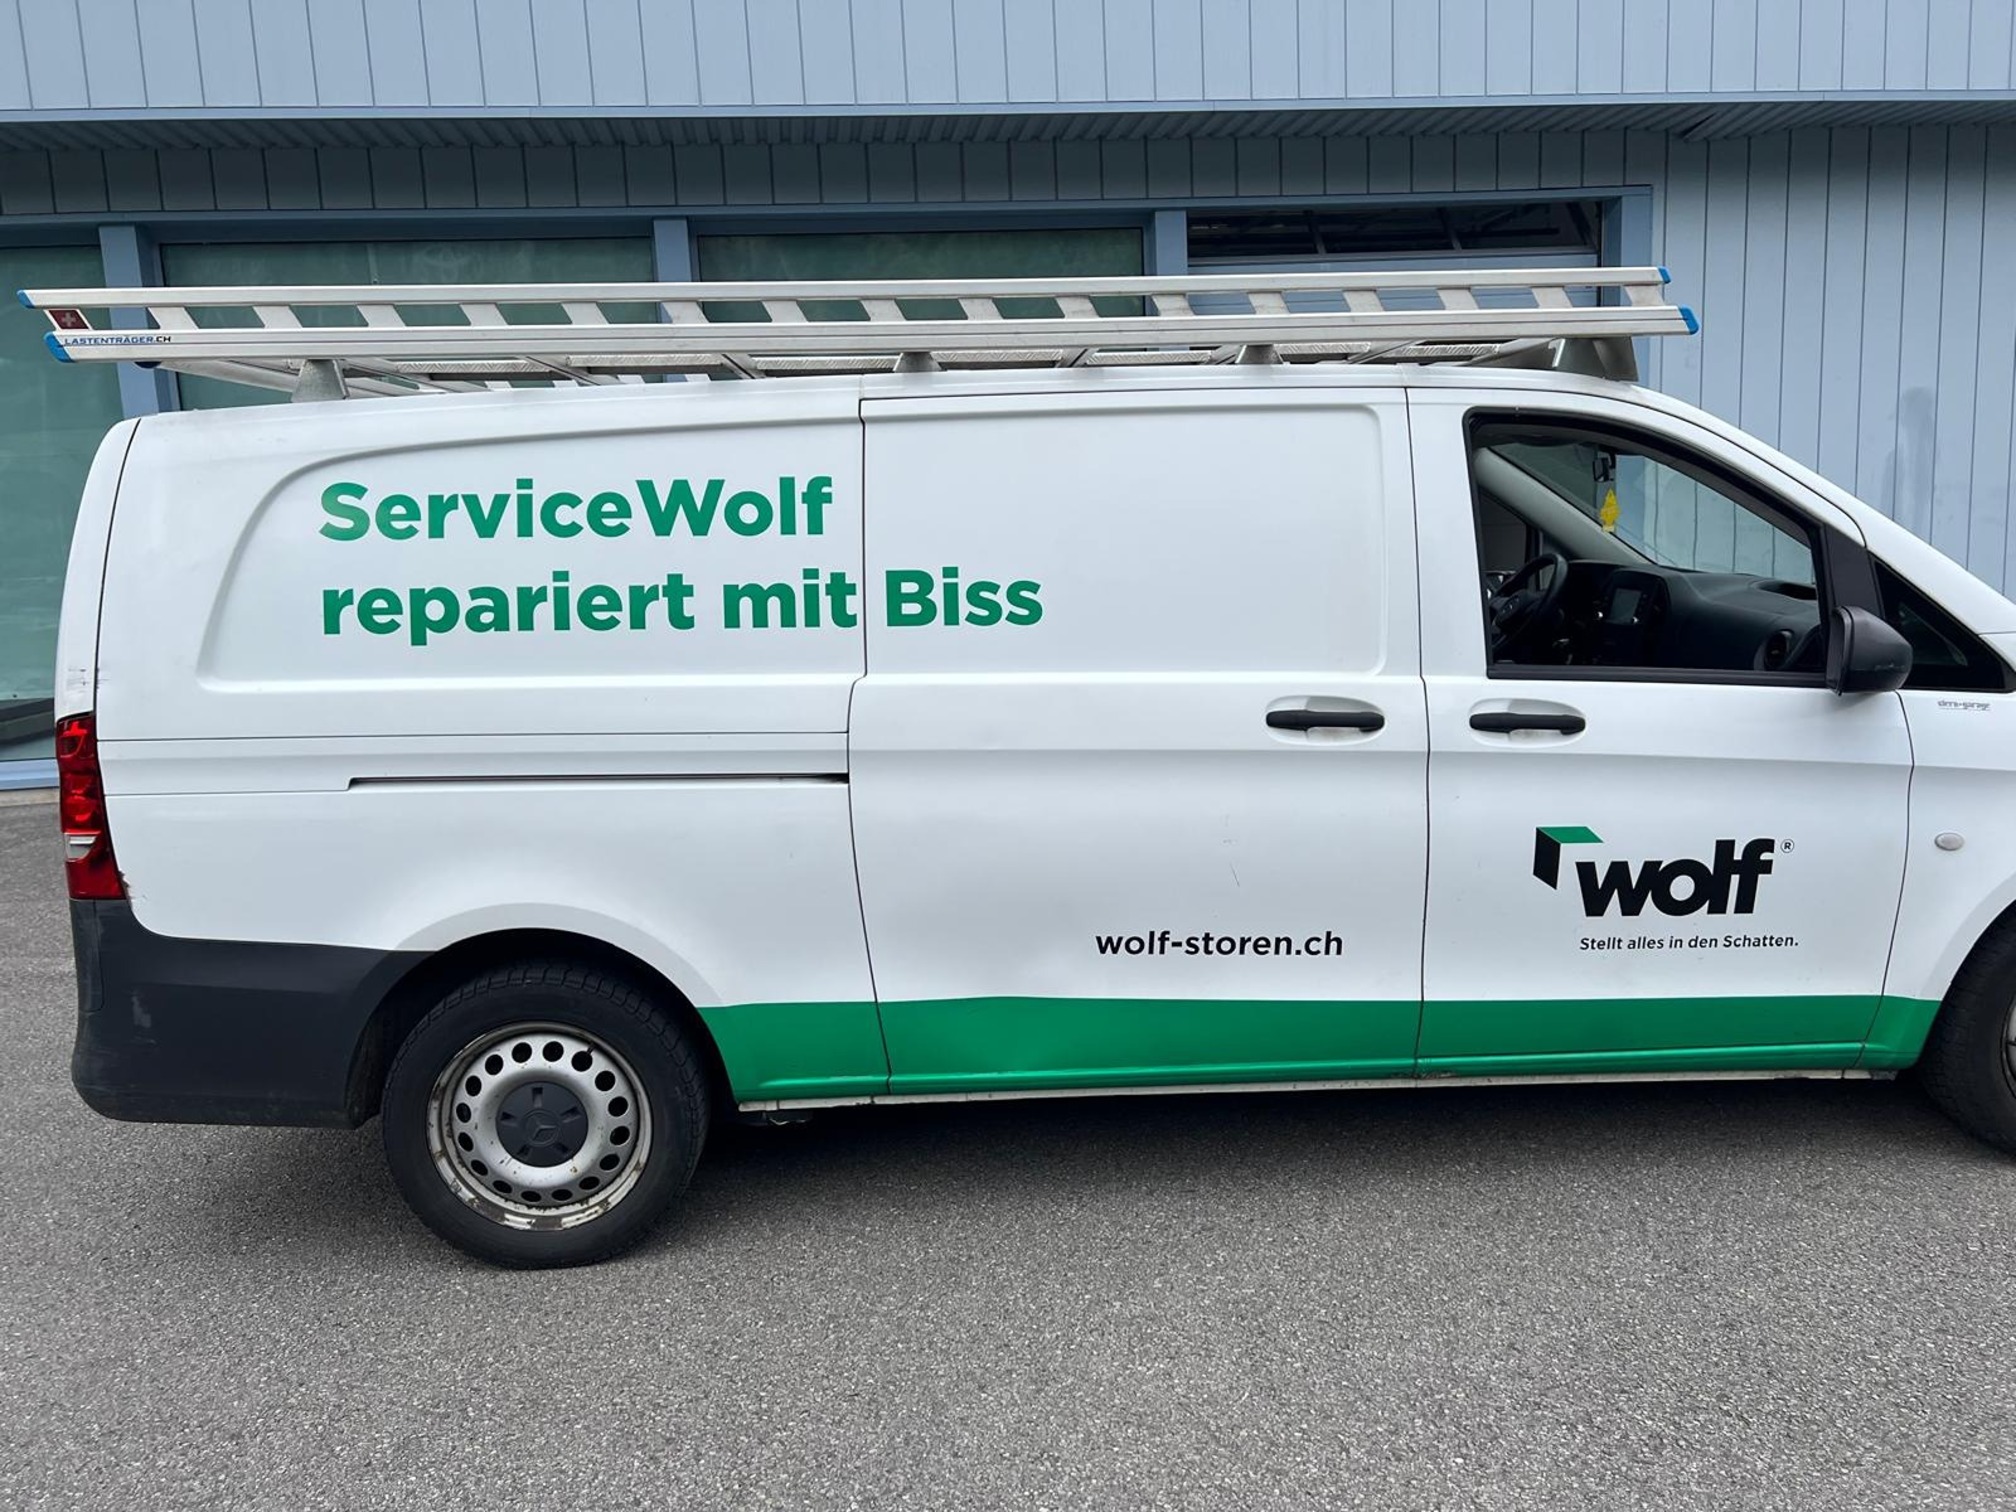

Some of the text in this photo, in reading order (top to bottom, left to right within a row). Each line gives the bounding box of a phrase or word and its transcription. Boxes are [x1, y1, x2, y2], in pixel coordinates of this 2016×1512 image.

[319, 475, 835, 543] ServiceWolf
[322, 565, 1045, 647] repariert mit Biss
[1574, 837, 1776, 918] wolf
[1095, 930, 1344, 956] wolf-storen.ch
[1579, 934, 1800, 951] Stellt alles in den Schatten.
